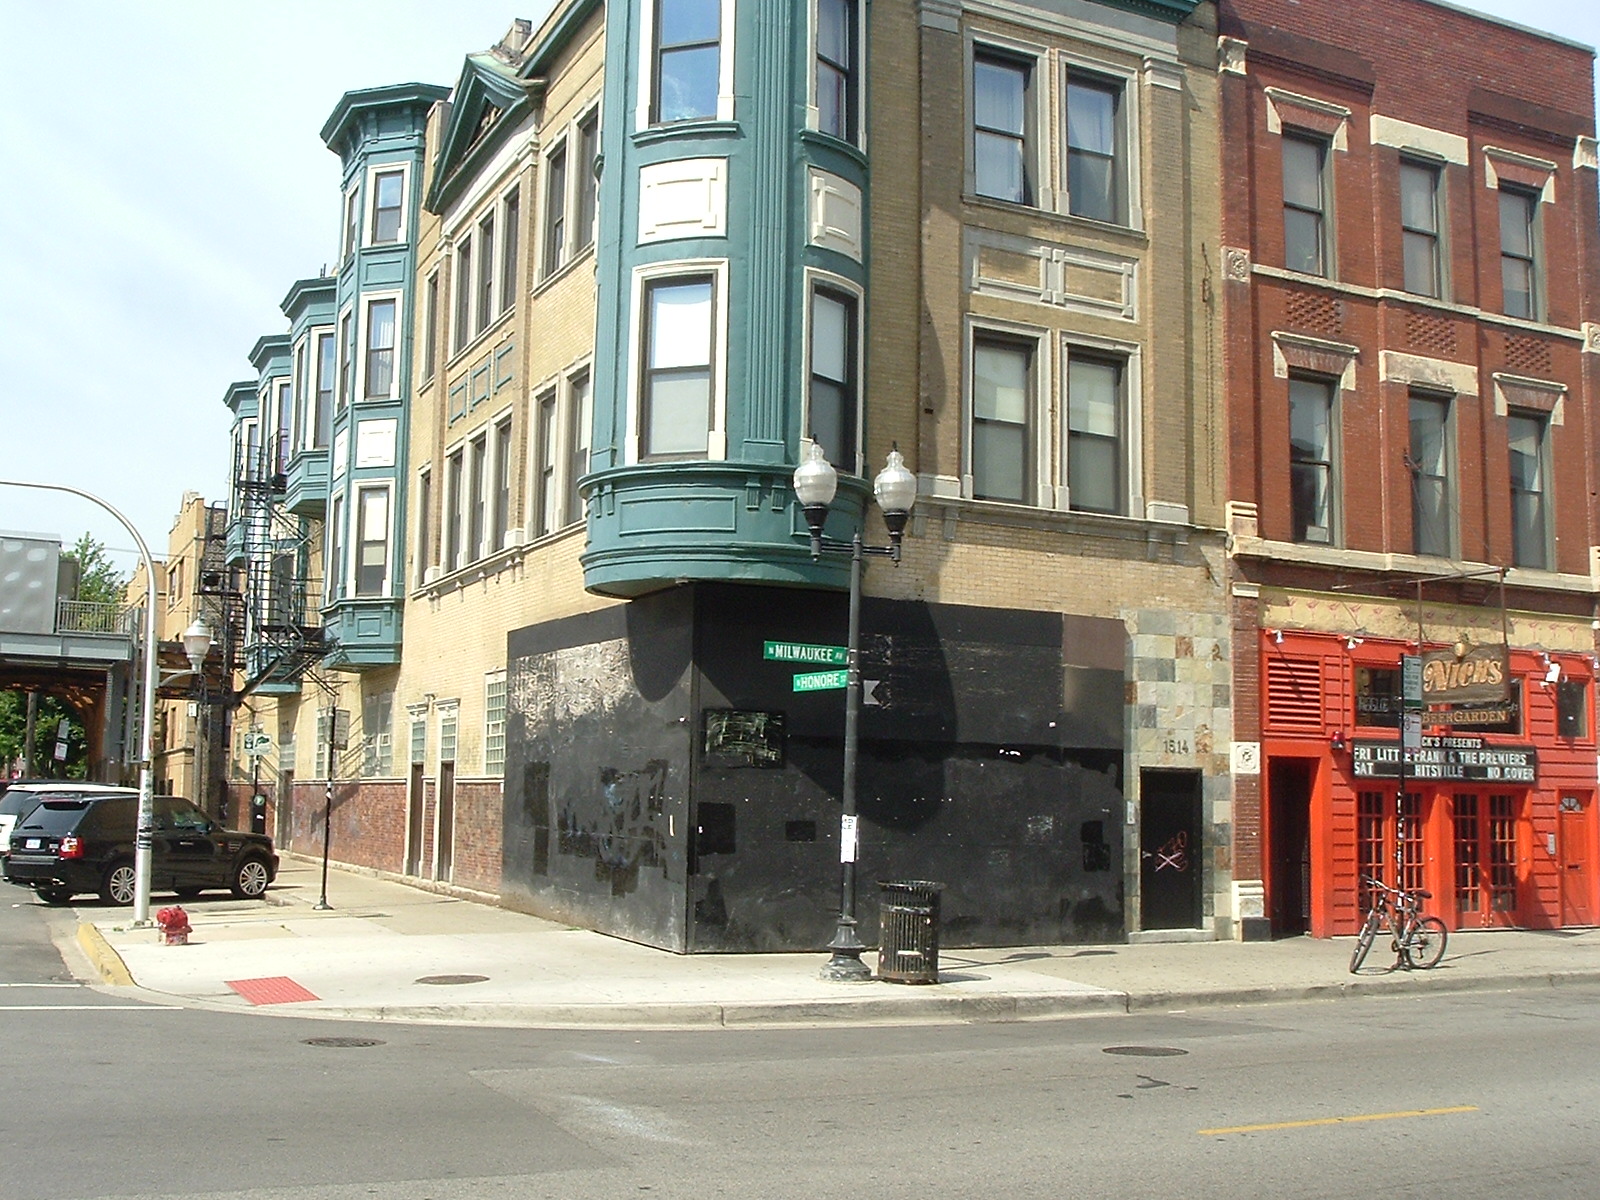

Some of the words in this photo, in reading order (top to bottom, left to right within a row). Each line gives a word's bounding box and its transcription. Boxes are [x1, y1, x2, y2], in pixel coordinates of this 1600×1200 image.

[768, 647, 774, 655] N
[775, 644, 833, 662] MILWAUKEE
[801, 673, 840, 689] HONORE
[1163, 739, 1189, 755] 1514
[1421, 736, 1441, 748] CK'S
[1442, 737, 1482, 749] PRESENTS
[1354, 747, 1371, 760] FRI
[1377, 748, 1411, 762] LITTE
[1413, 750, 1446, 764] FRANK
[1459, 752, 1478, 764] THE
[1479, 752, 1527, 766] PREMIERS
[1354, 761, 1374, 775] SAT
[1414, 764, 1464, 778] HITSVILLE
[1487, 767, 1501, 779] NO
[1503, 767, 1534, 780] COVER
